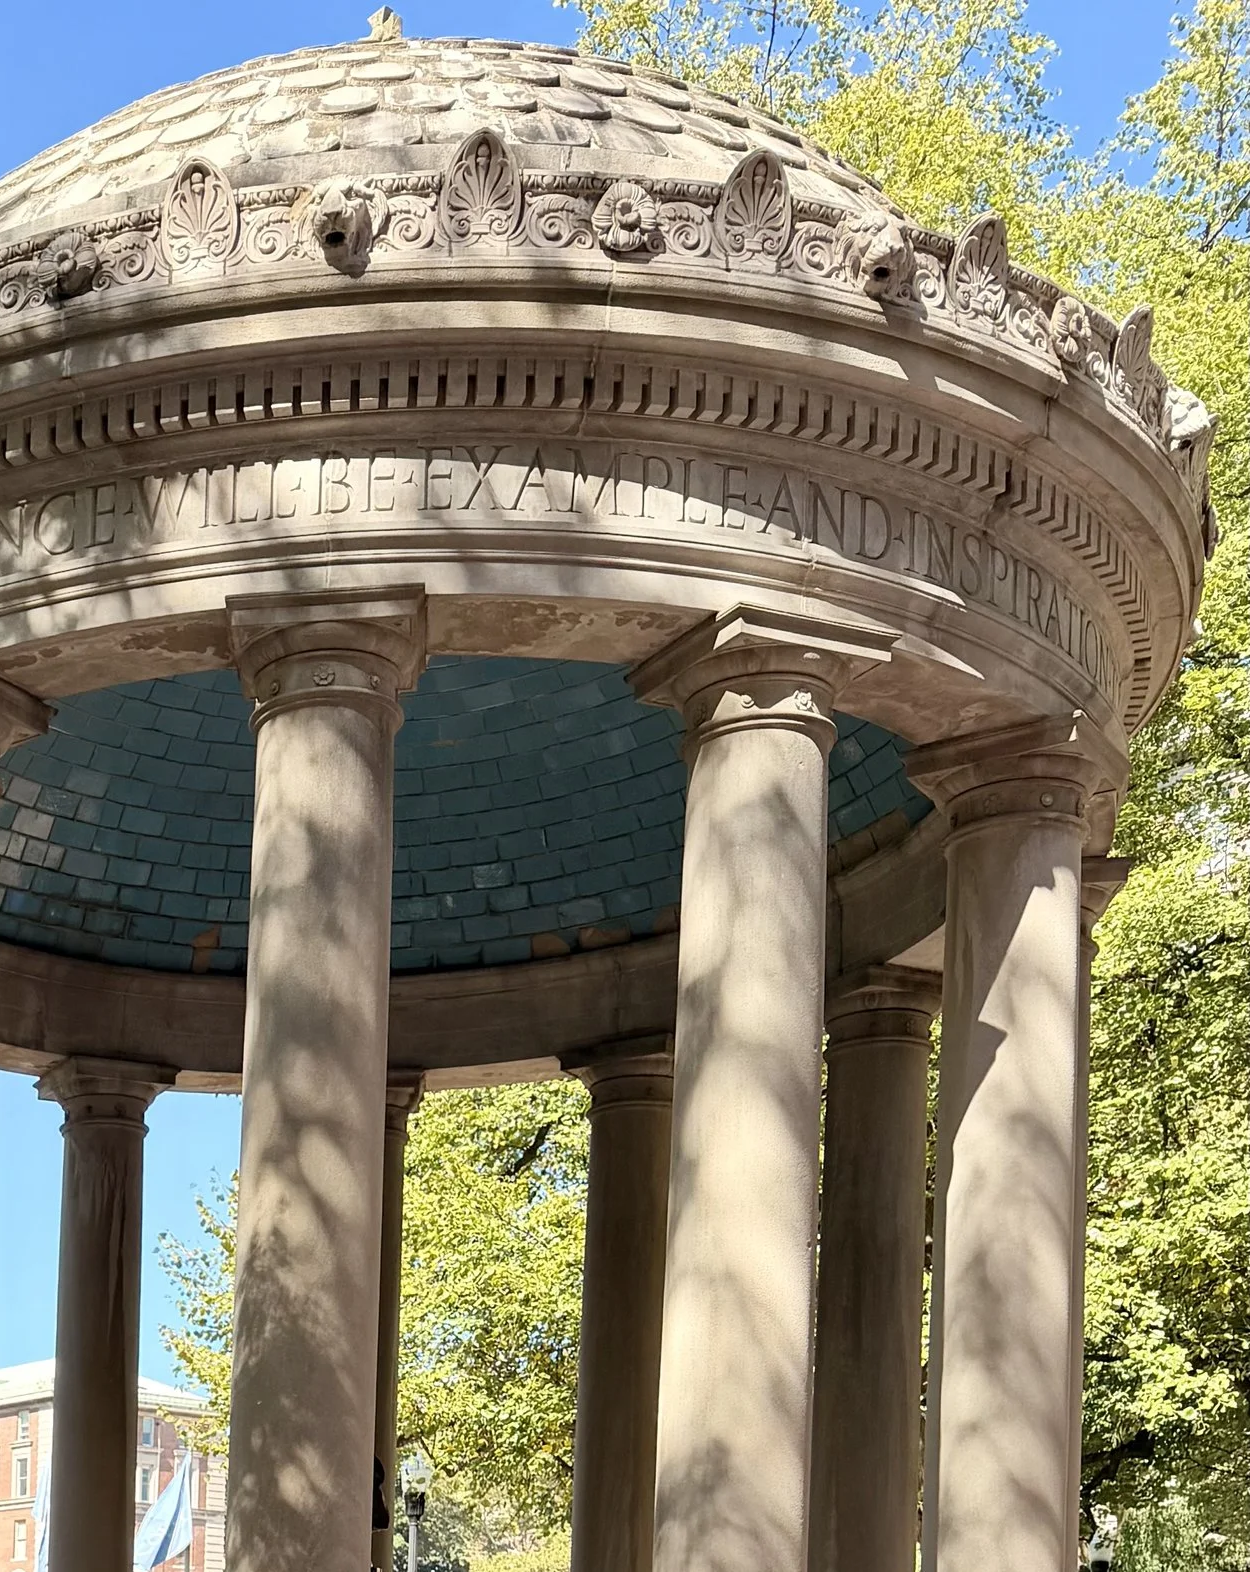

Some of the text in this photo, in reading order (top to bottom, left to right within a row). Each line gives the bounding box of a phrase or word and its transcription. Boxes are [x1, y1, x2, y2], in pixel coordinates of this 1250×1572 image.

[130, 456, 297, 533] WILL
[311, 448, 396, 515] BE
[417, 445, 748, 529] EXAMPLE
[756, 472, 892, 560] AND
[901, 506, 1109, 693] INSPIRATION
